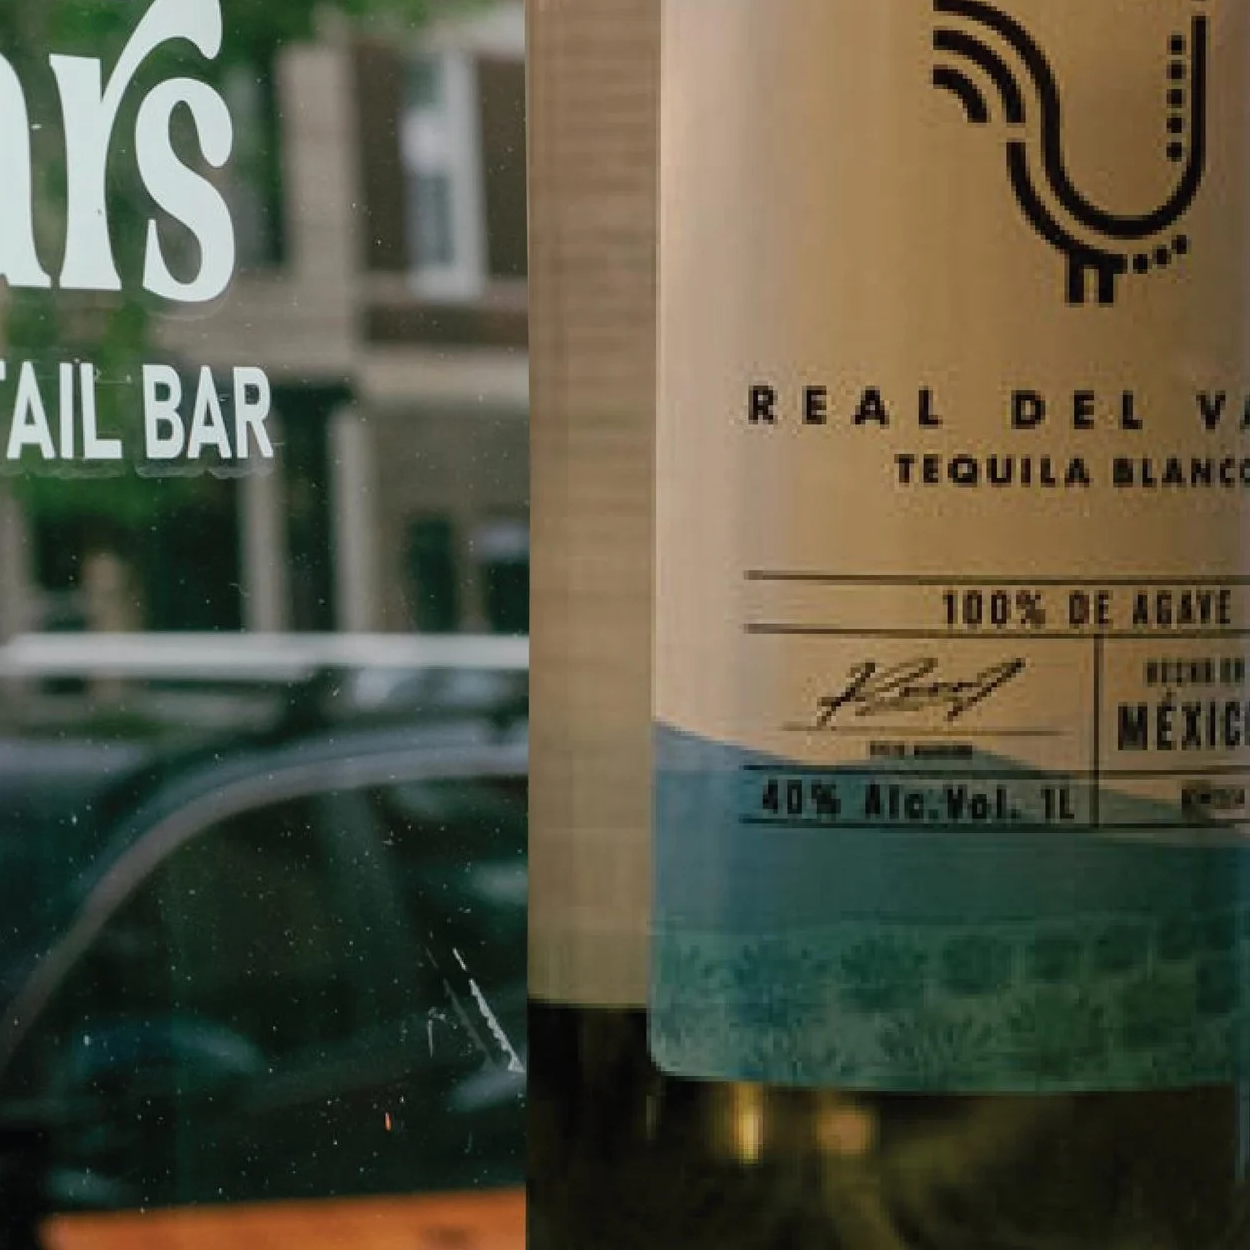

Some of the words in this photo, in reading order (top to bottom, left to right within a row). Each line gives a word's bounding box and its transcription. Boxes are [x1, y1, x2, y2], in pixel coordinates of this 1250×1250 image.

[142, 363, 274, 461] BAR
[749, 386, 943, 429] REAL
[1011, 389, 1143, 430] DEL
[895, 453, 1091, 488] TEQUILA
[943, 589, 1046, 627] 100%
[1069, 590, 1113, 628] DE
[1132, 589, 1231, 627] AGAVE
[1117, 686, 1250, 750] MÉXIC
[762, 779, 842, 815] 40%
